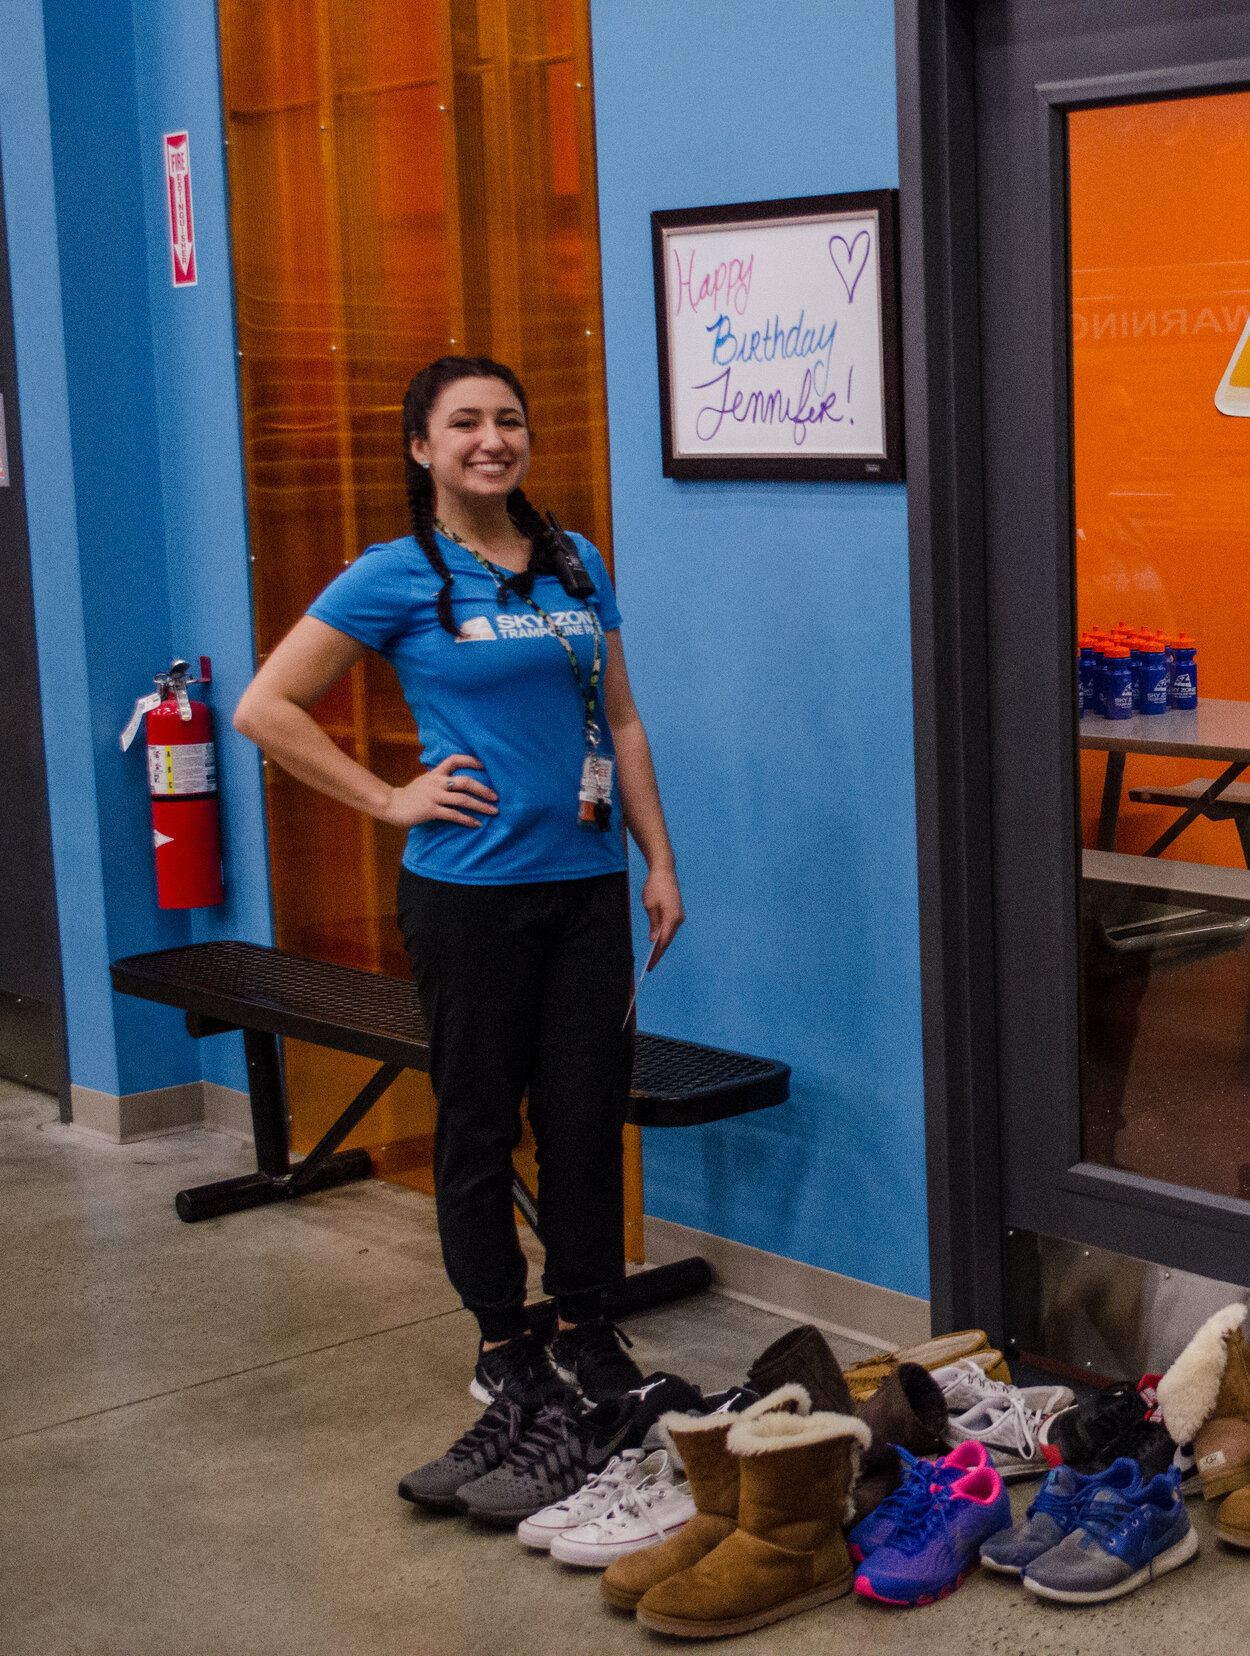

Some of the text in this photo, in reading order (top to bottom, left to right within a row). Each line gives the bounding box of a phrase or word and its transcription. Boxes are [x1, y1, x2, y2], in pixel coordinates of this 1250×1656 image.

[171, 152, 185, 172] FIRE
[176, 173, 187, 265] EXTINGUISHER
[673, 248, 755, 316] Happy
[496, 613, 545, 629] SKY
